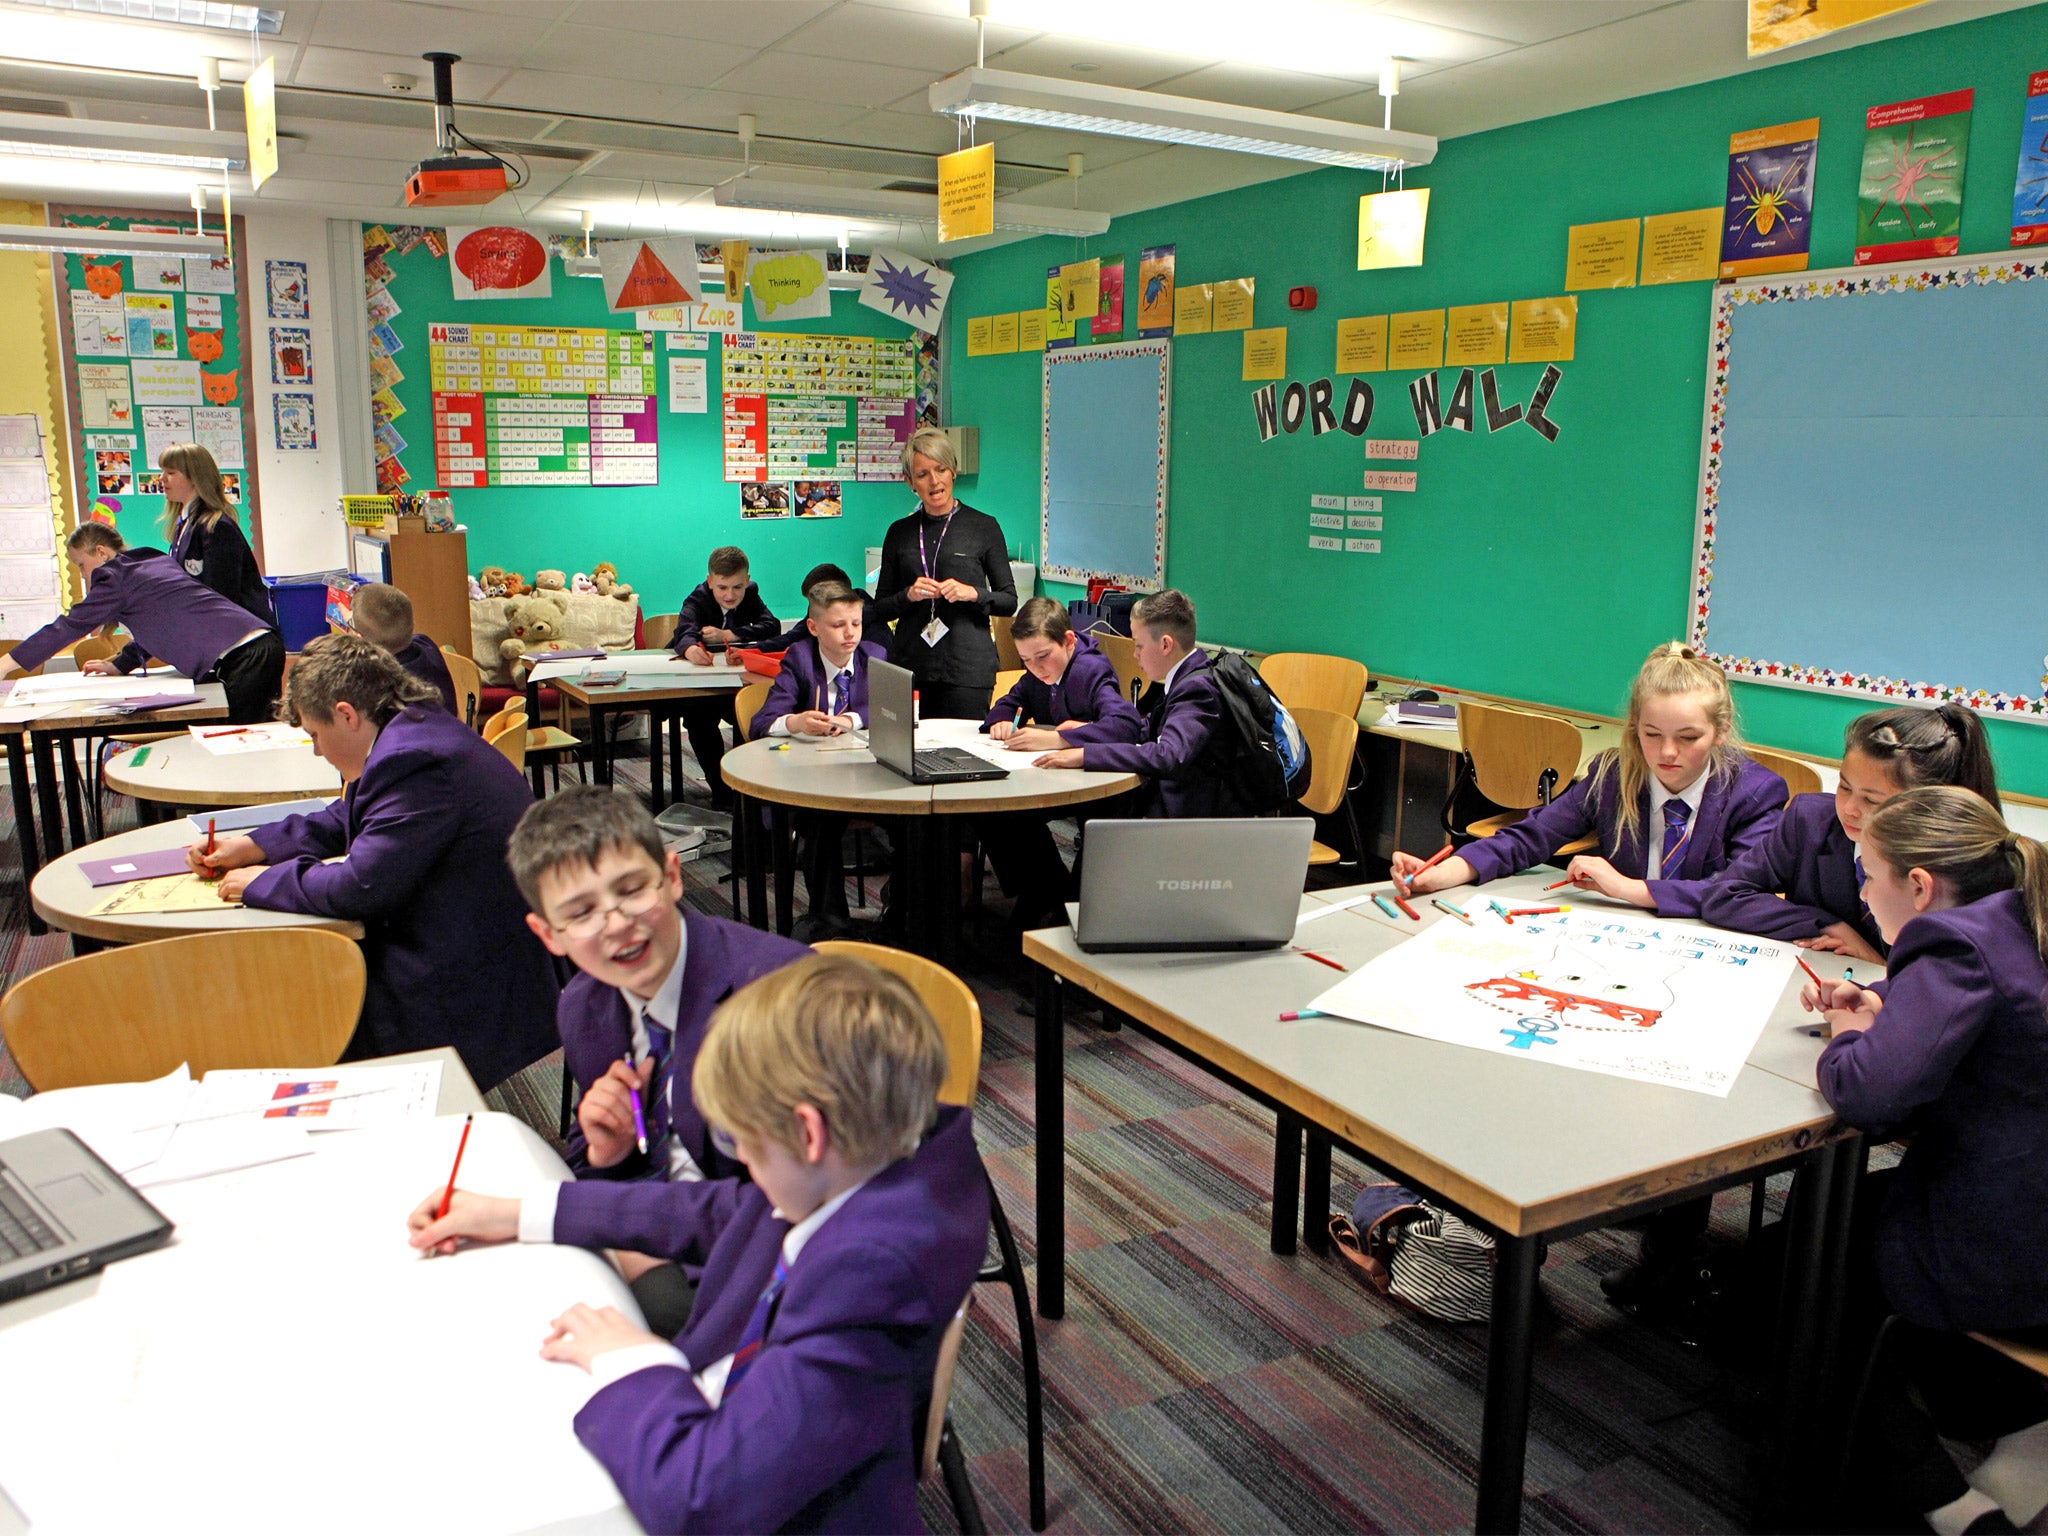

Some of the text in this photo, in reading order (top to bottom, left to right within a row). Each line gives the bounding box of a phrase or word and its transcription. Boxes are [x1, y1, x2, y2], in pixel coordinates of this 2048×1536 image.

[1871, 104, 1924, 119] Comprehension
[768, 278, 801, 288] Thinking
[187, 308, 220, 316] Gingerbread
[697, 303, 735, 326] Zone
[431, 327, 448, 342] 44
[448, 327, 469, 335] SOUNDS
[724, 333, 737, 347] 44
[737, 334, 756, 342] SOUNDS
[738, 341, 756, 349] CHART
[1252, 363, 1562, 442] WORD WALL
[92, 435, 130, 448] Tom Thumb
[1370, 442, 1417, 459] strategy
[1365, 473, 1417, 488] co-operation
[1318, 497, 1375, 510] noun thing
[1311, 516, 1376, 528] adjective describe
[1318, 538, 1375, 550] verb action
[1156, 880, 1232, 890] TOSHIBA
